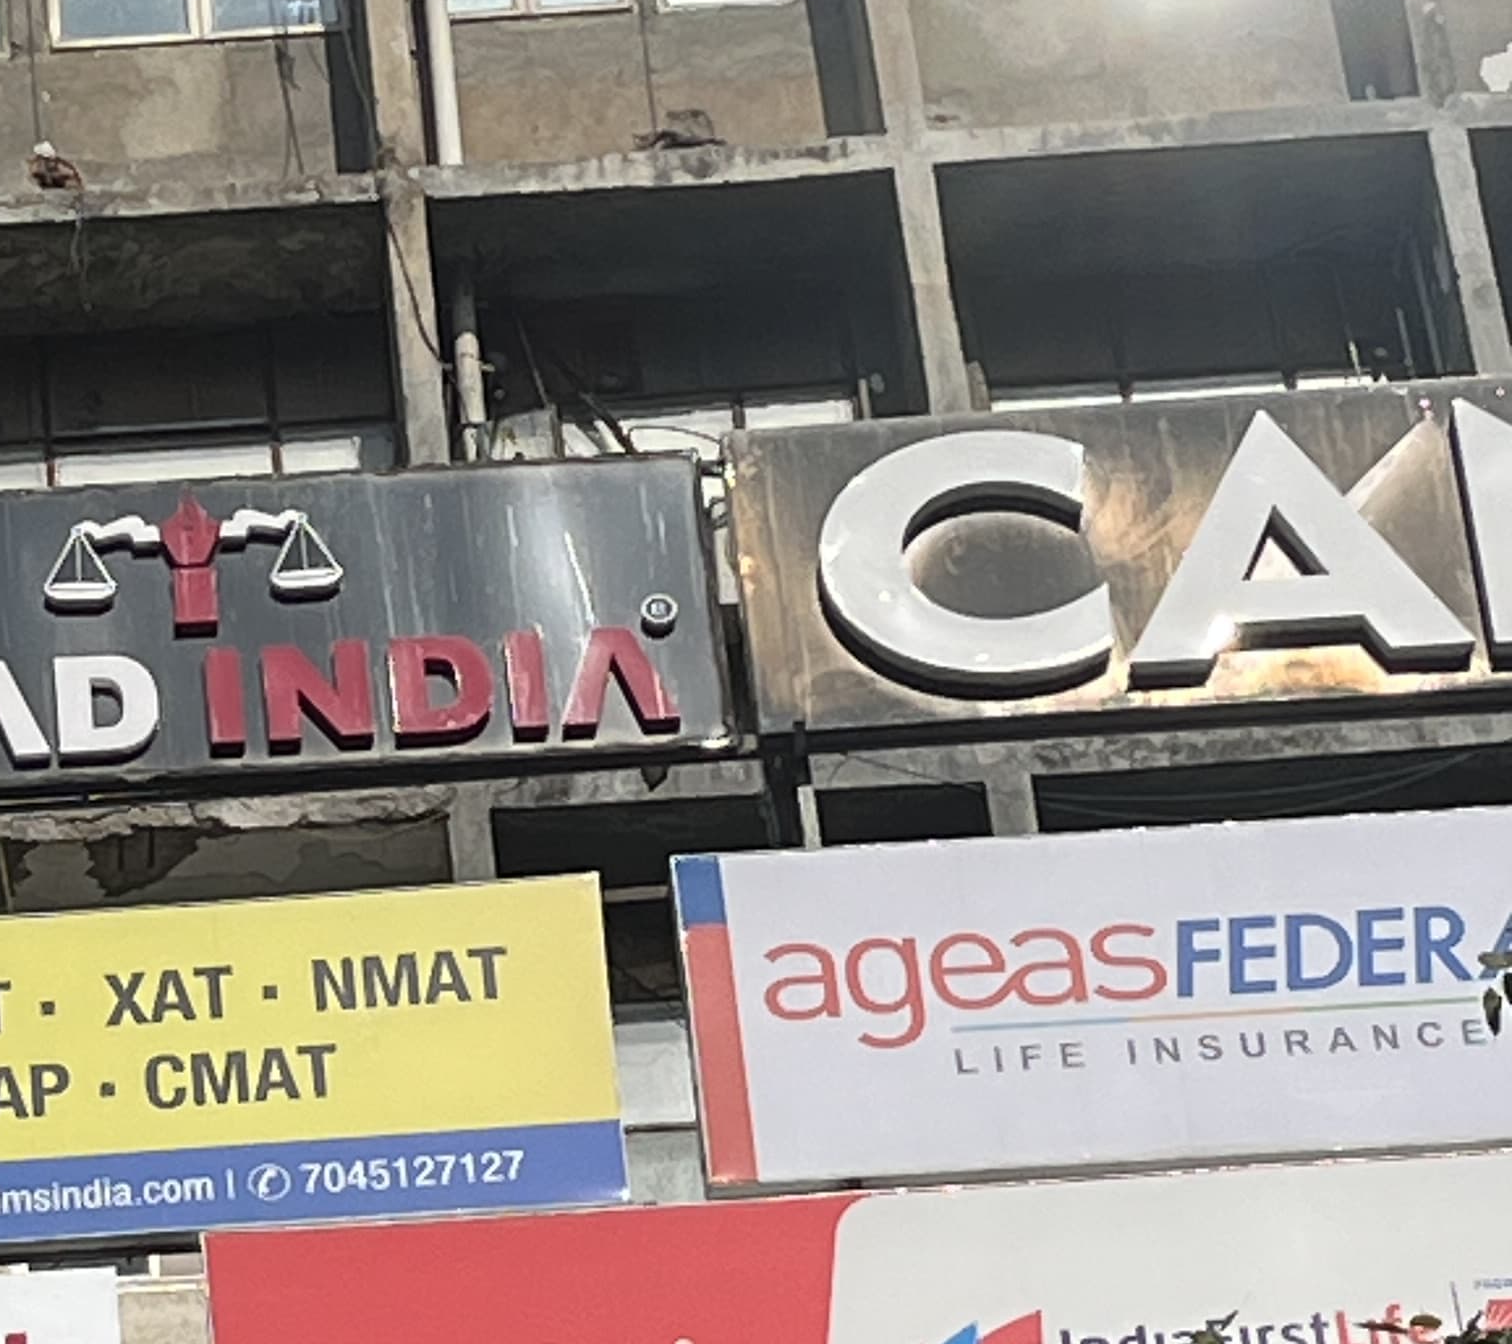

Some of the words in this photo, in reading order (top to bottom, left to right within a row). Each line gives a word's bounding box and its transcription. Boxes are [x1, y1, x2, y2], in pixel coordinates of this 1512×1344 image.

[819, 398, 1512, 699] CA
[204, 626, 681, 756] INDIA
[104, 965, 233, 1027] XAT
[312, 945, 508, 1012] NMAT
[145, 1043, 338, 1109] CMAT
[955, 1041, 1088, 1075] LIFE
[1127, 1019, 1487, 1065] INSURANCE
[300, 1149, 525, 1196] 7045127127
